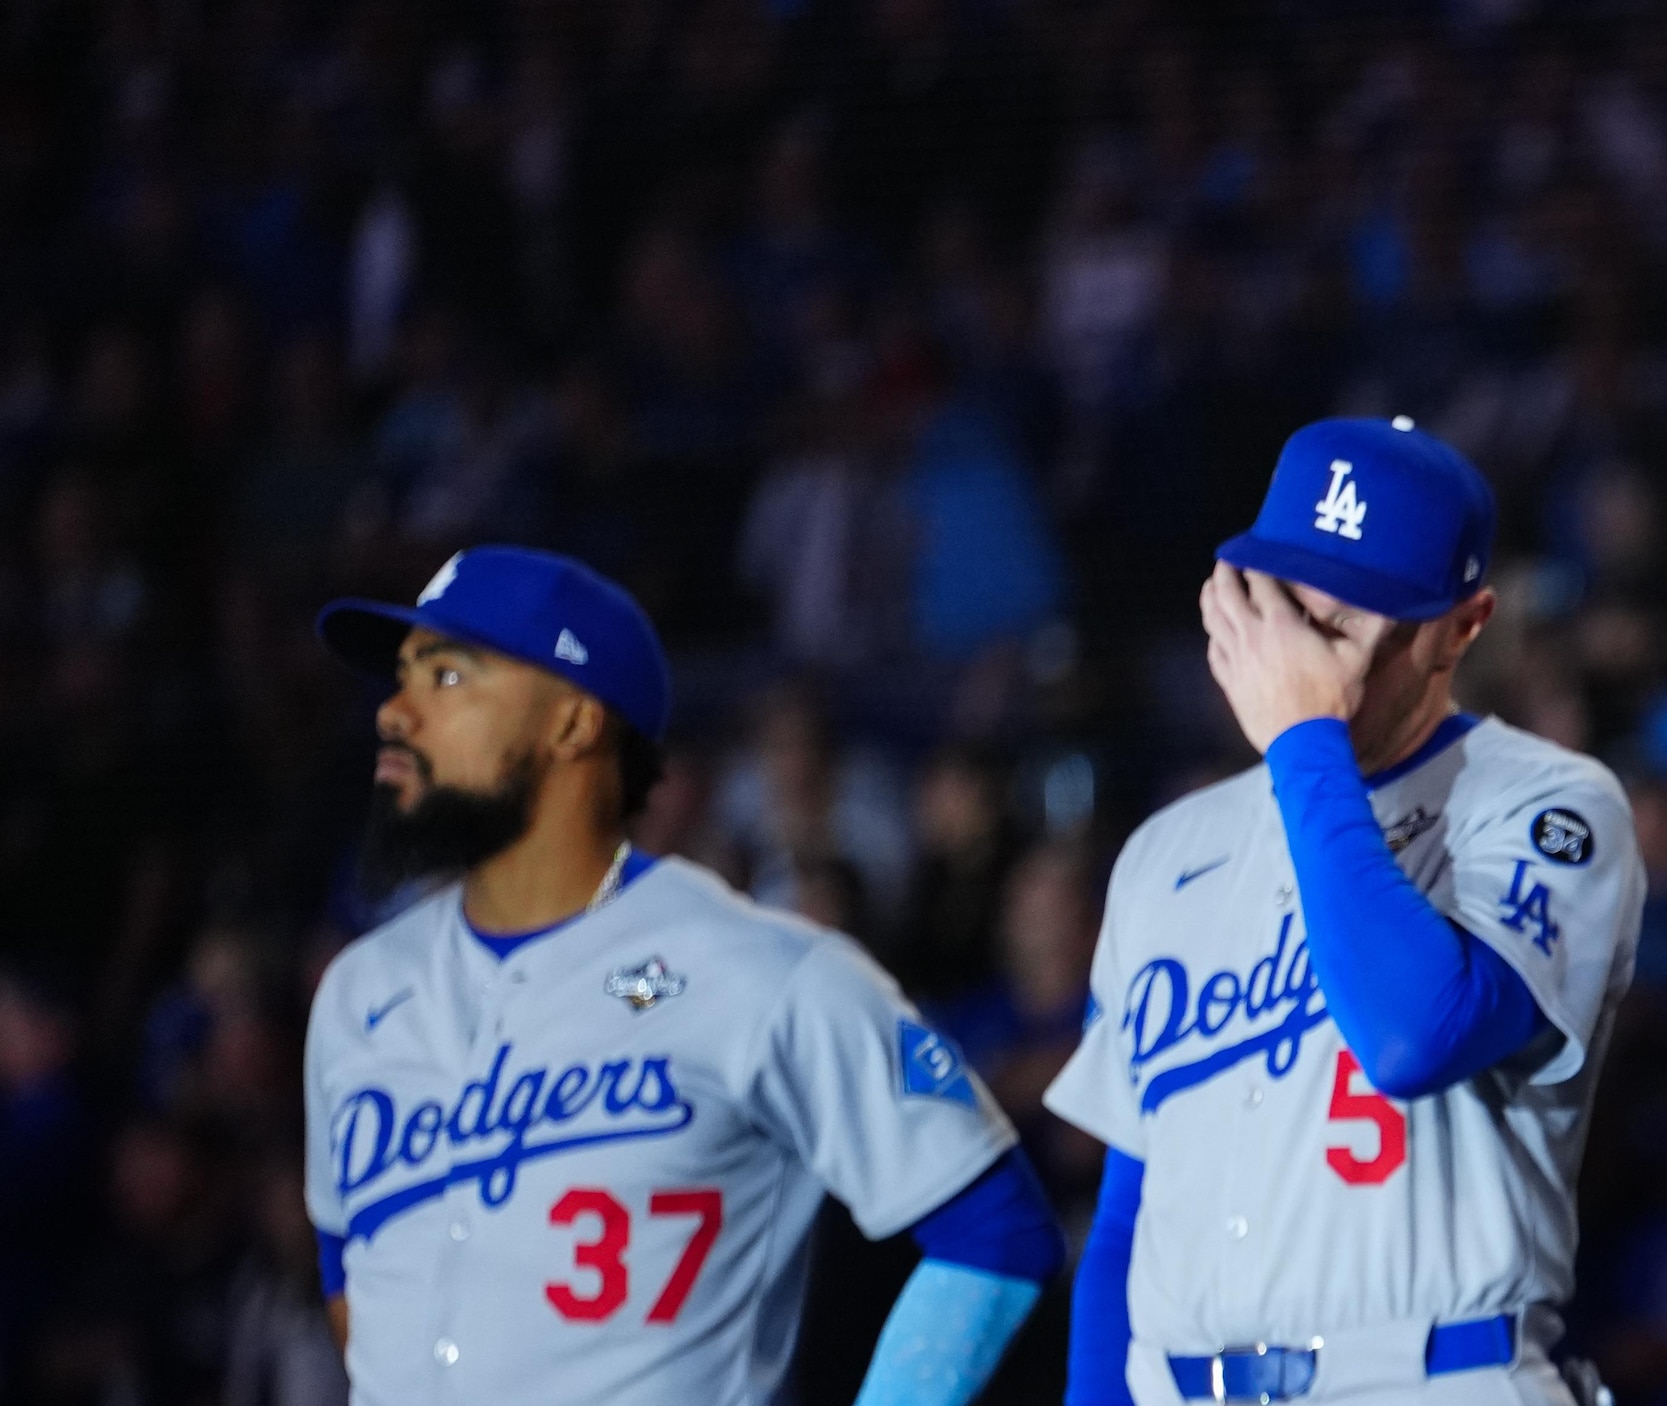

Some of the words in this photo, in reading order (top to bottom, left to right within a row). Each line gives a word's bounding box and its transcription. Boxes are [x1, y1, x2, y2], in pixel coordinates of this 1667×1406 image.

[1314, 459, 1366, 540] LA
[1499, 858, 1560, 958] LA
[1122, 913, 1325, 1079] Dodg
[330, 1043, 692, 1210] Dodgers
[1324, 1047, 1408, 1188] 5
[545, 1187, 723, 1326] 37
